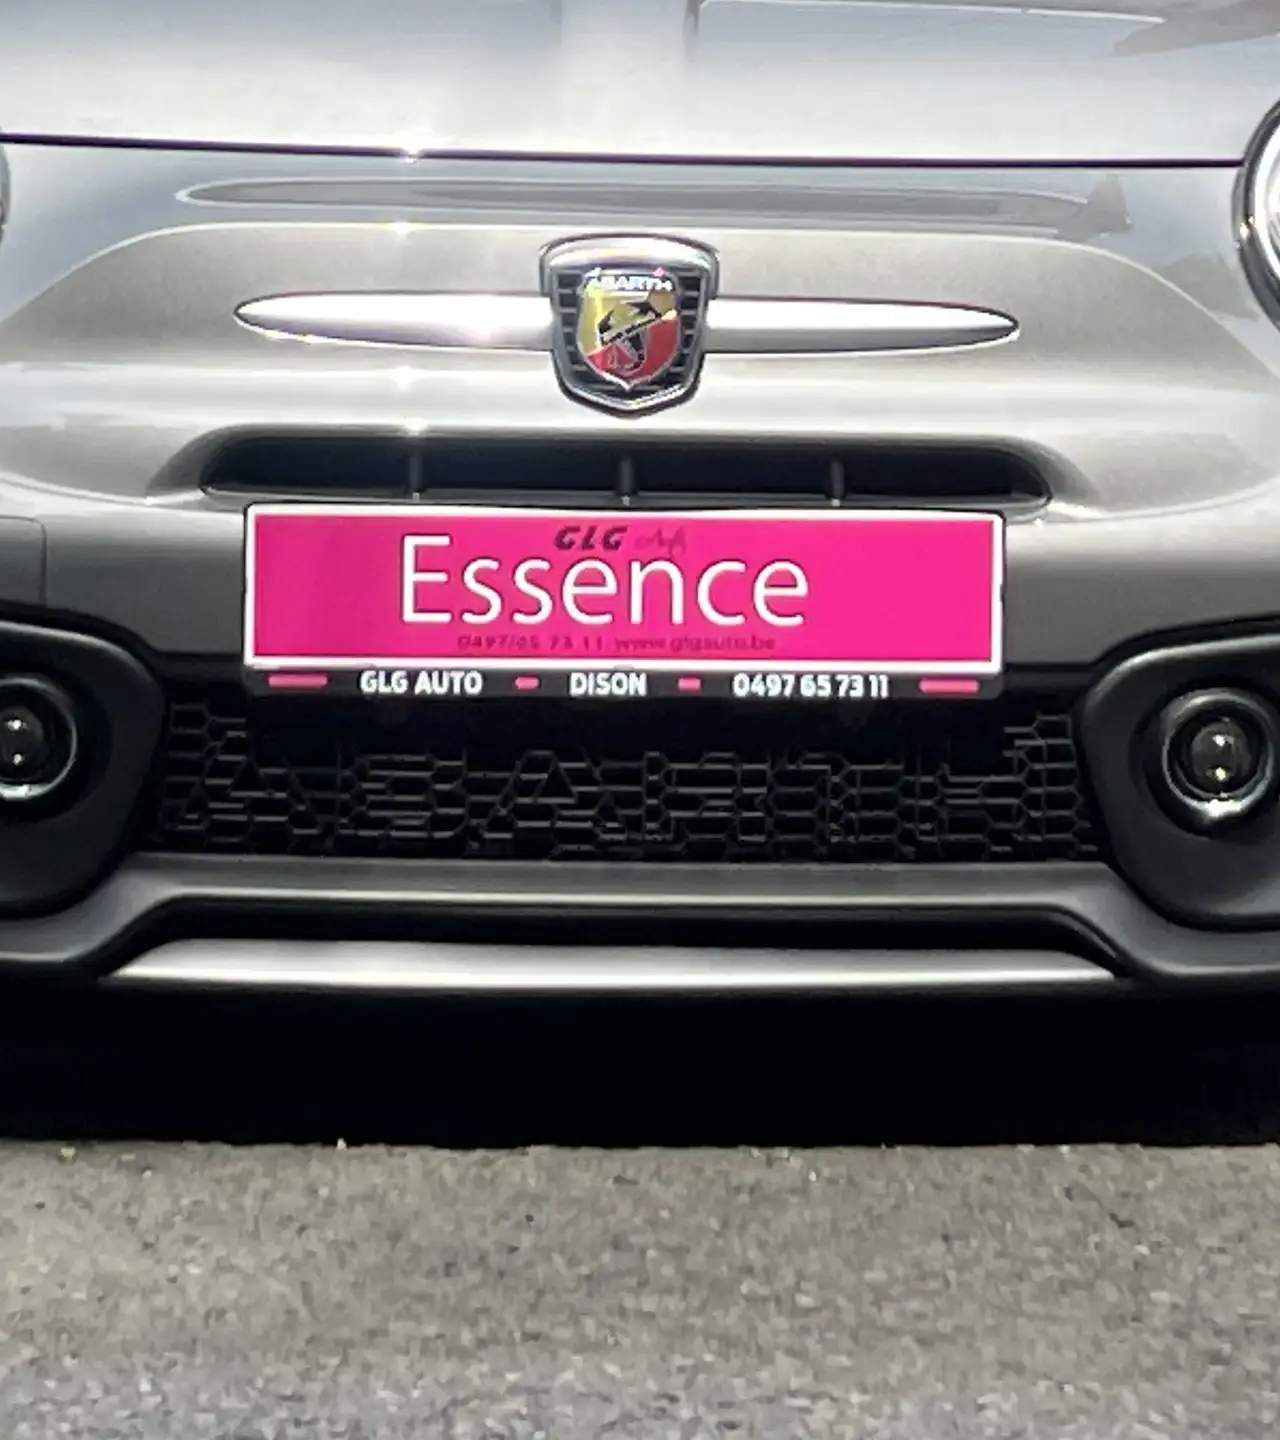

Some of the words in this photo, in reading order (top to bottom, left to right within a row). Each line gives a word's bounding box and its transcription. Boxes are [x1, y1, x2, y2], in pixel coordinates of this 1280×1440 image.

[554, 525, 628, 551] GLG
[401, 534, 809, 626] Essence
[360, 670, 407, 694] GLG
[413, 670, 483, 695] AUTO
[569, 672, 648, 696] DISON
[732, 673, 795, 697] 0497
[800, 674, 832, 697] 65
[836, 675, 864, 698] 73
[868, 675, 888, 698] 11
